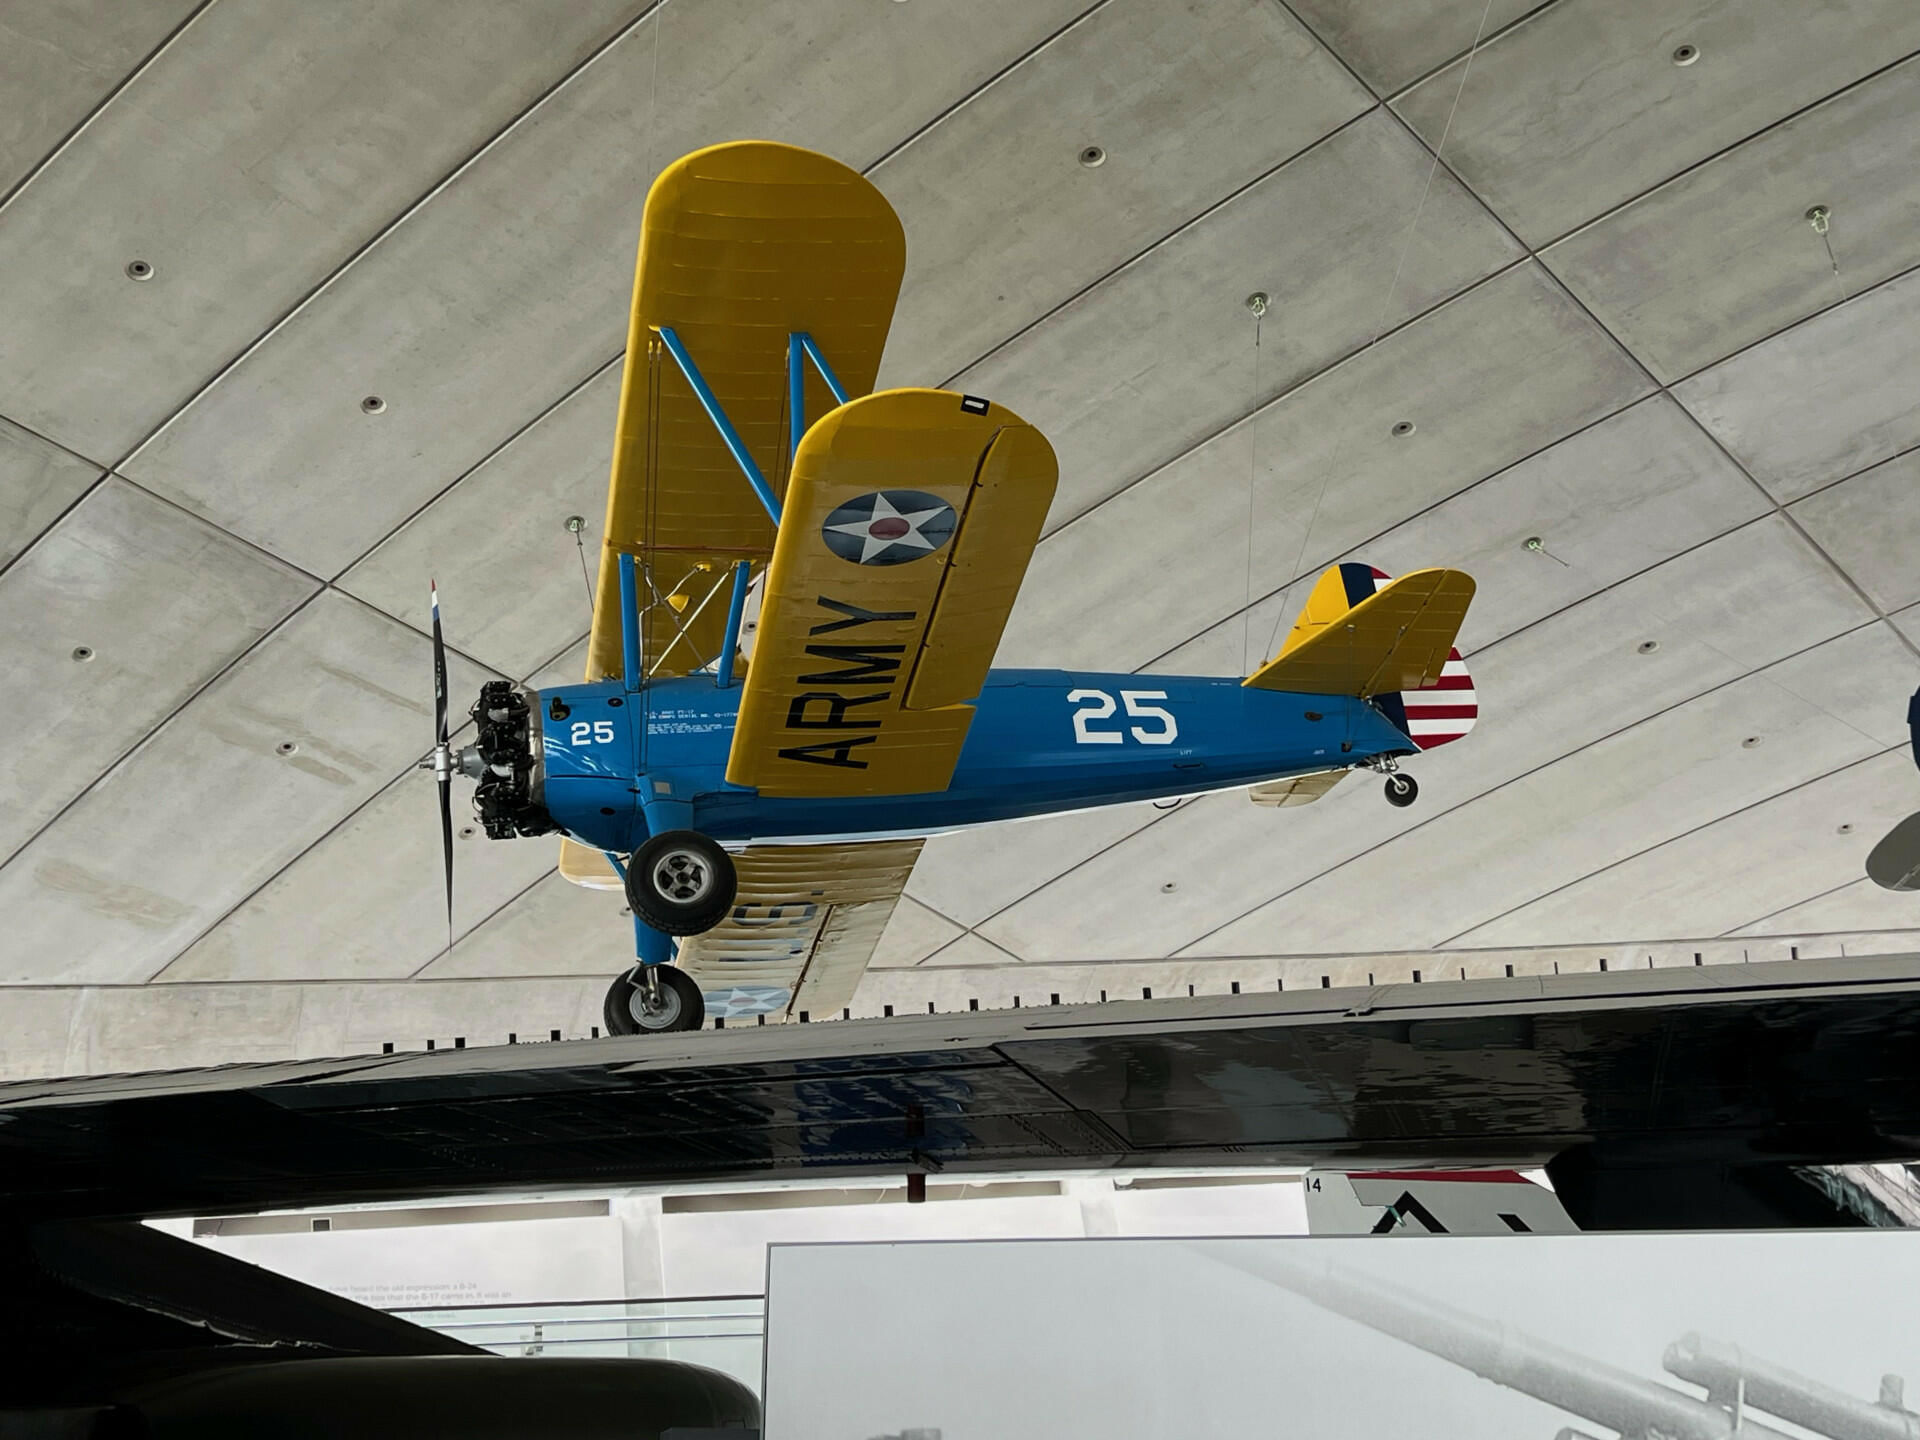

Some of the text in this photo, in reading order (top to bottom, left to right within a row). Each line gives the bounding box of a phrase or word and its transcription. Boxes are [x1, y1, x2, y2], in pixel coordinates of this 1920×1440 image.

[778, 595, 917, 769] ARMY
[570, 720, 614, 746] 25
[1066, 689, 1178, 746] 25
[1306, 1177, 1322, 1193] 14
